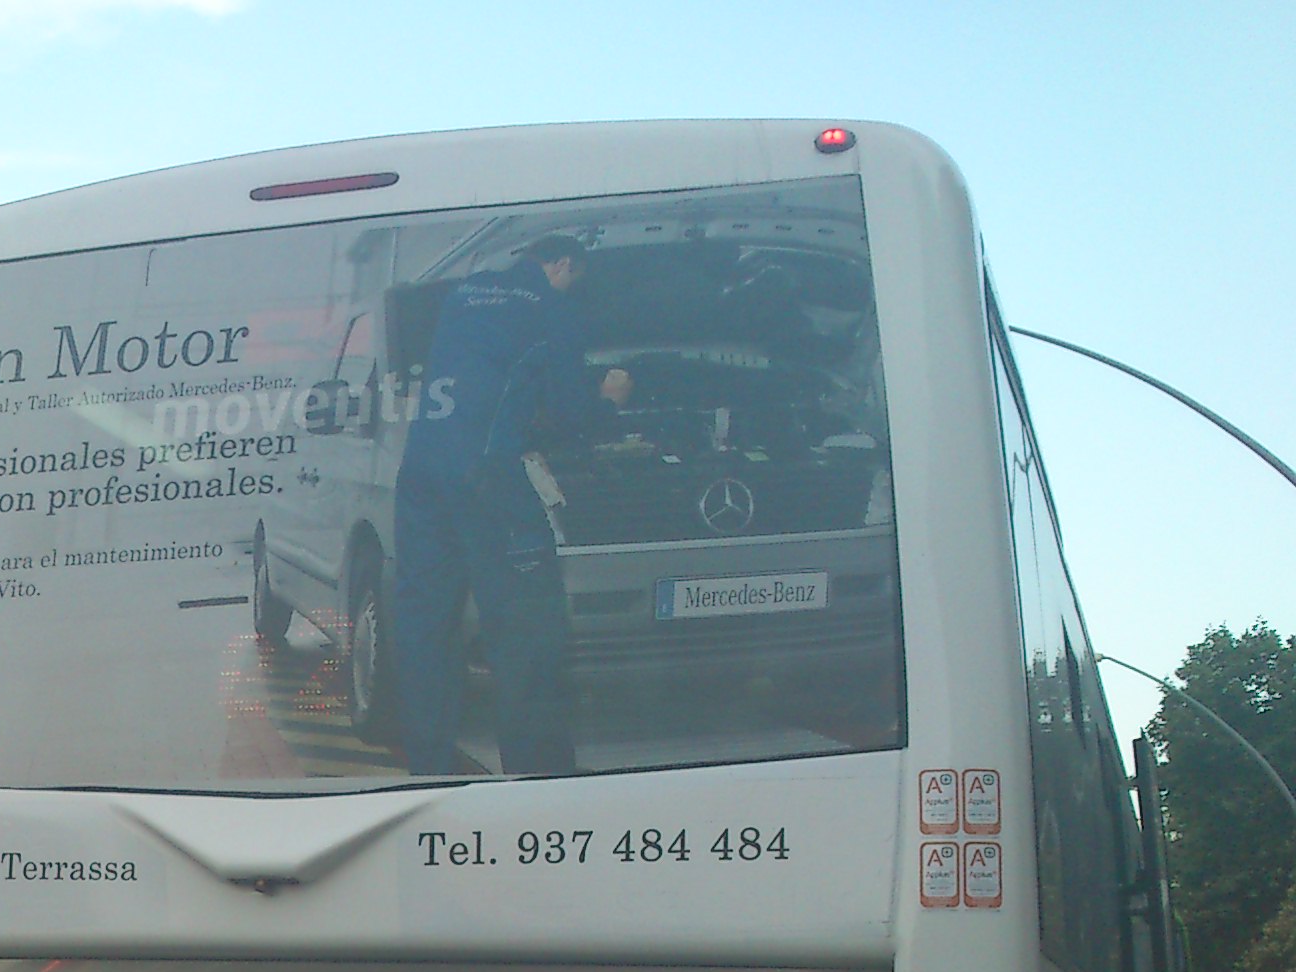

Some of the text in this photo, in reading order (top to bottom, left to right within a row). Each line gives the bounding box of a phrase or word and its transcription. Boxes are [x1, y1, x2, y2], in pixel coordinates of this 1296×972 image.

[47, 320, 249, 379] Motor
[12, 400, 23, 415] y
[28, 393, 74, 411] Taller
[78, 384, 164, 407] Autorizado
[155, 364, 456, 437] moventis
[137, 430, 298, 472] prefieren
[47, 467, 284, 516] profesionales.
[39, 546, 59, 569] el
[64, 540, 223, 568] mantenimiento
[685, 581, 816, 609] Mercedes-Benz
[0, 851, 139, 881] Terrassa
[418, 826, 790, 866] Tel. 937 484 484
